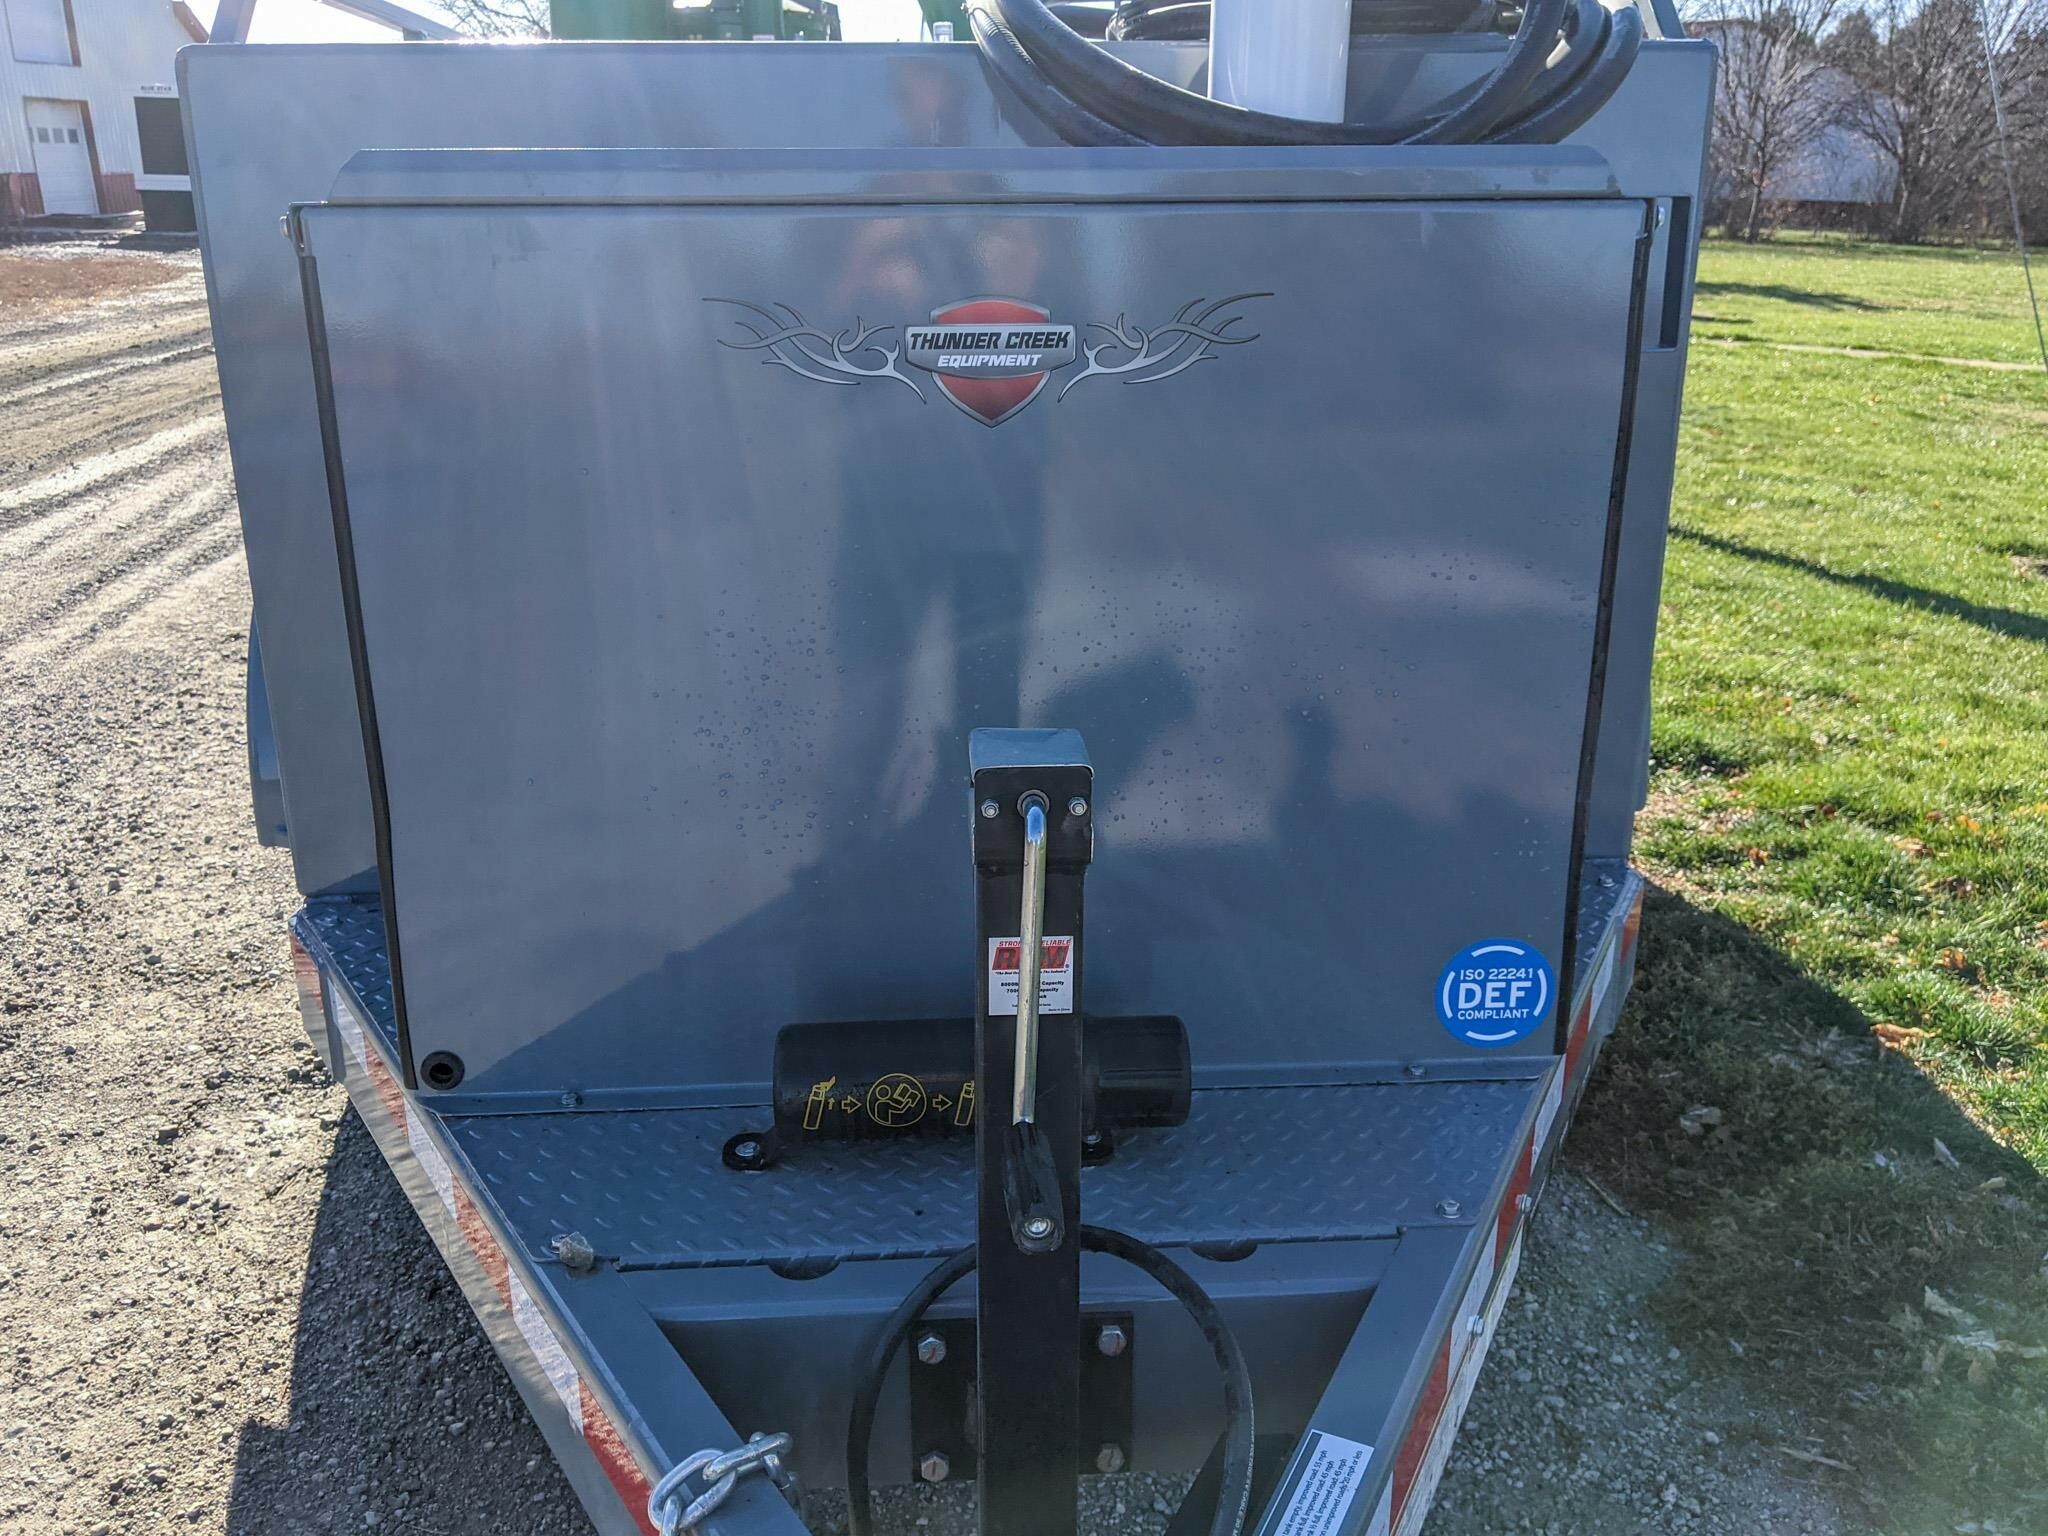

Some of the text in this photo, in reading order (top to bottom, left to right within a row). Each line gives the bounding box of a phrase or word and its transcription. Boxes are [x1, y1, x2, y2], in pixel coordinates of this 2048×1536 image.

[910, 331, 1070, 350] THUNDER CREEK
[937, 354, 1042, 368] EQUIPMENT
[1041, 938, 1071, 946] ELIABLE
[1460, 968, 1533, 980] ISO 22241
[1458, 981, 1532, 1009] DEF
[1457, 1009, 1530, 1020] COMPLIANT
[1298, 1480, 1313, 1505] improved
[1318, 1450, 1328, 1461] mph
[1305, 1491, 1320, 1516] improved
[1325, 1460, 1334, 1472] mph
[1318, 1489, 1333, 1514] improved
[1338, 1458, 1347, 1471] mph
[1324, 1498, 1341, 1530] unimproved
[1347, 1465, 1356, 1477] mph
[1352, 1450, 1363, 1460] less
